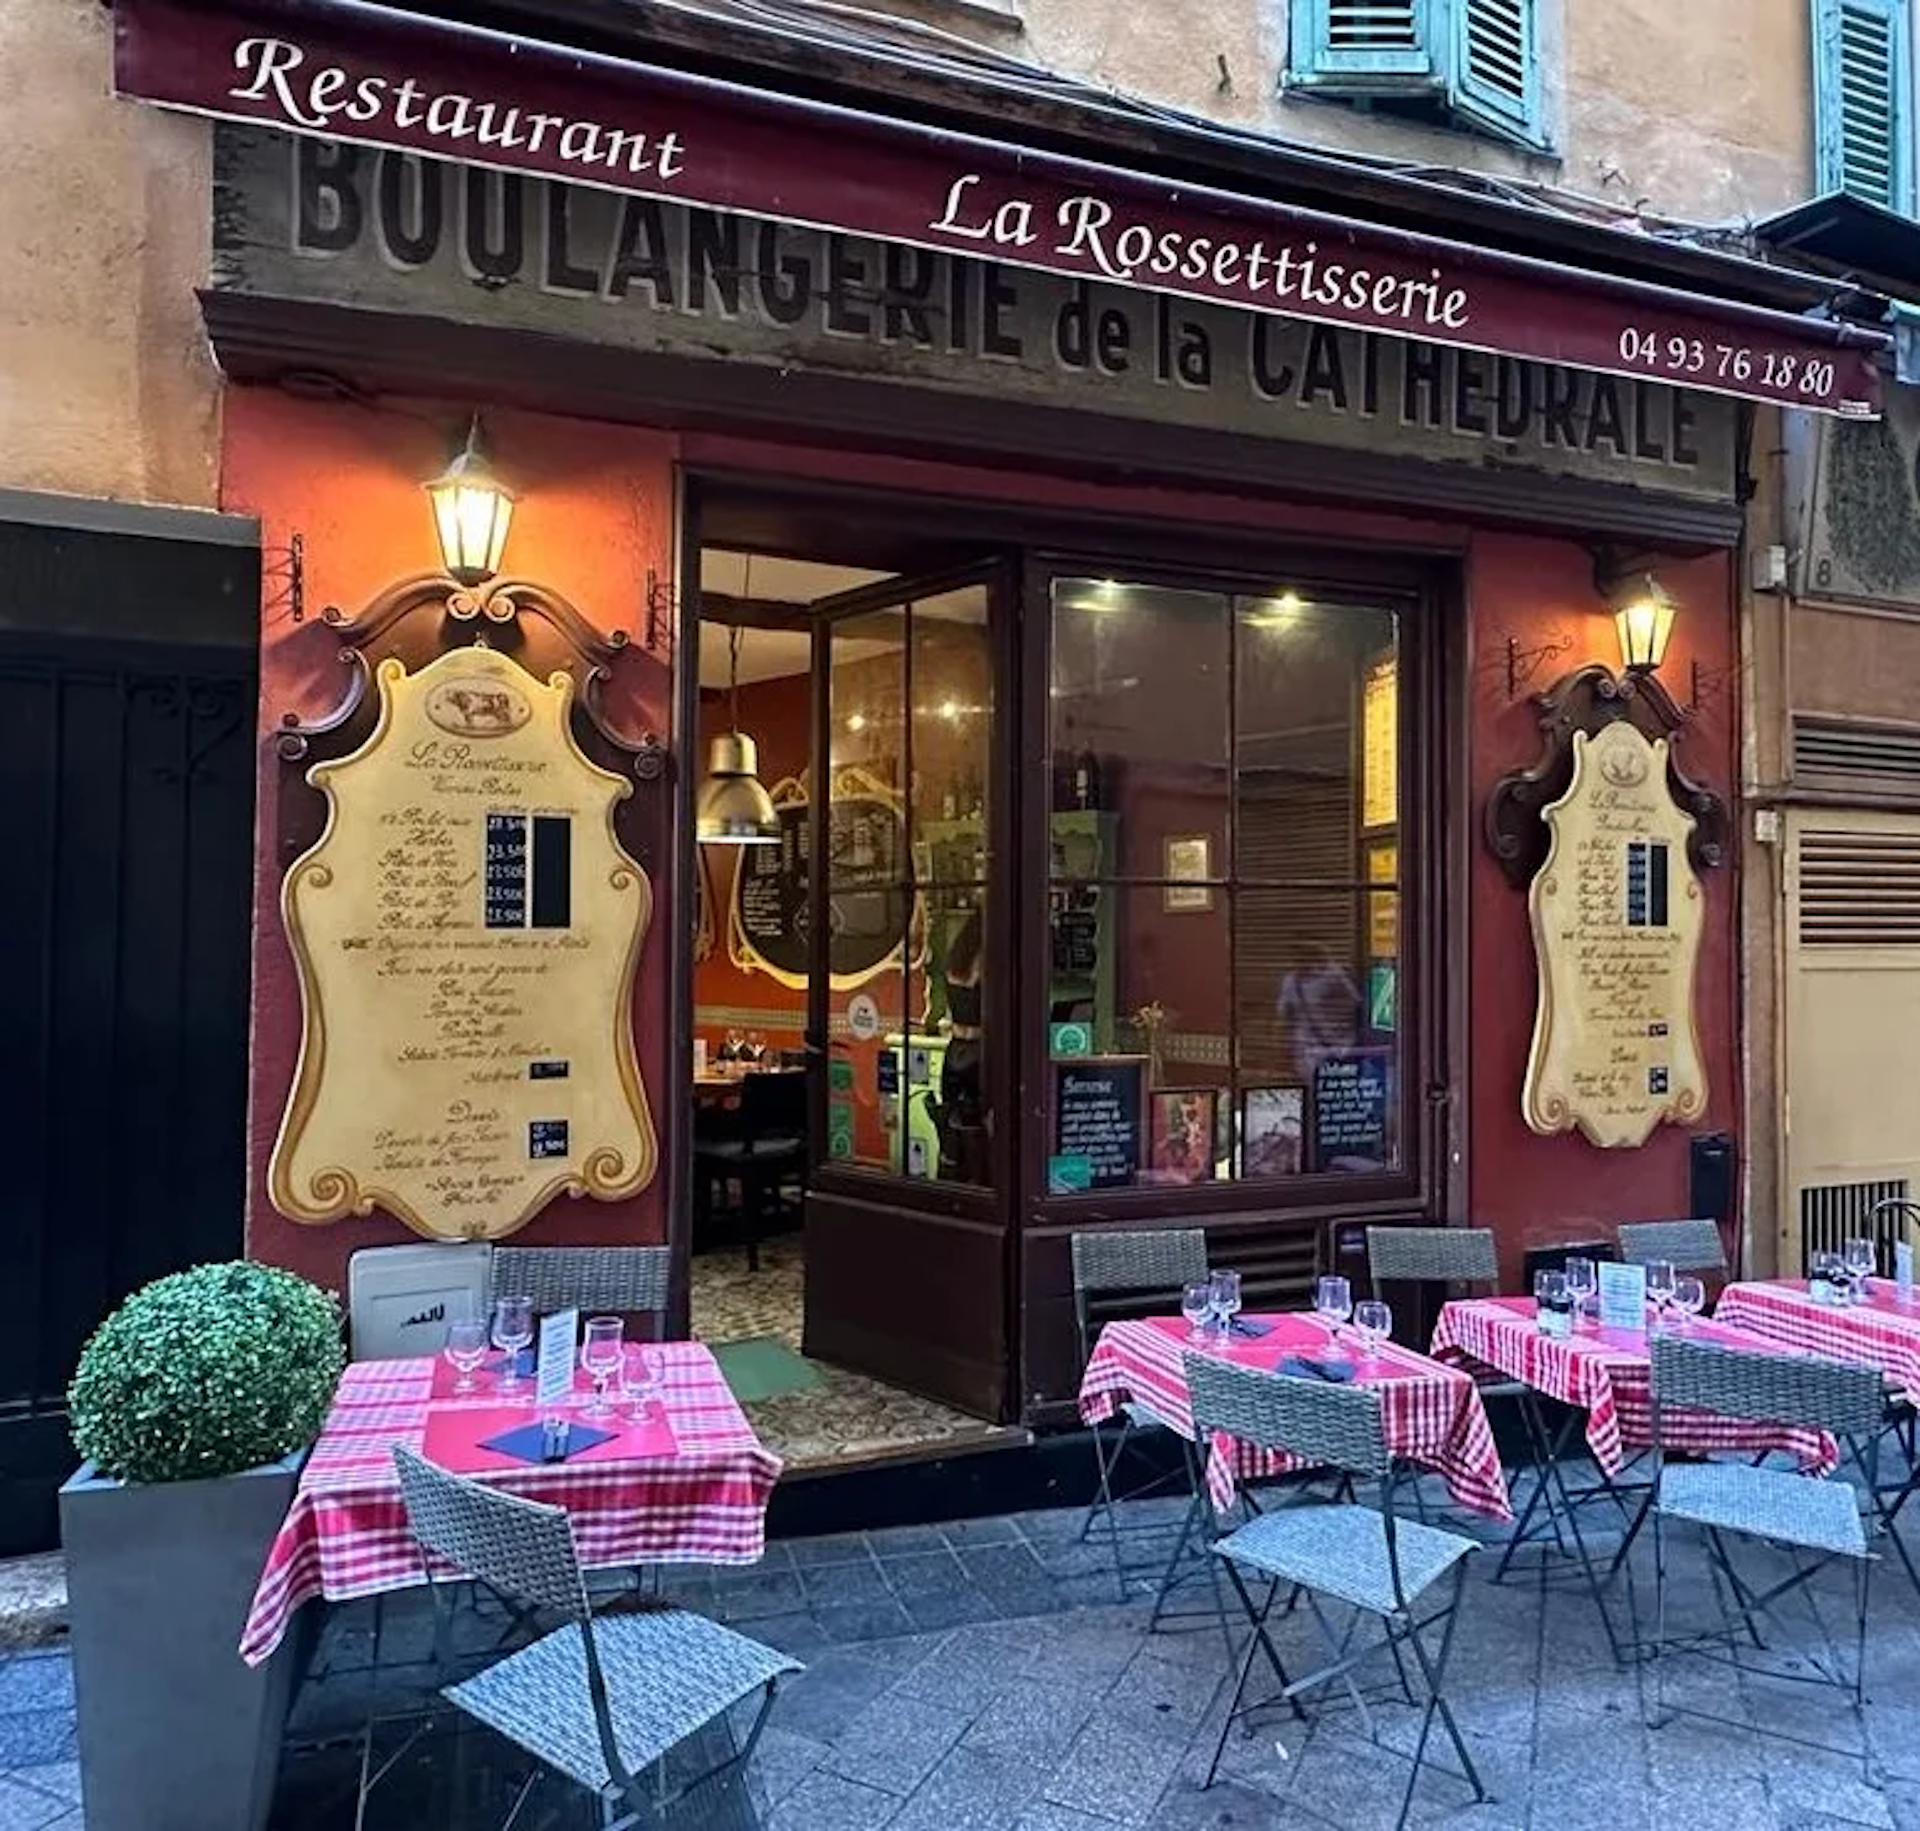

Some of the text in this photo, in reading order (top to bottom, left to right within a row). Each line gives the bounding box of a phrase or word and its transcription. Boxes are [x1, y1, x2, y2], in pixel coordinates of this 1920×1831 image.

[229, 37, 688, 180] Restaurant
[291, 136, 1024, 361] BOULANGERIE
[1054, 276, 1130, 378] de
[1154, 294, 1212, 391] la
[929, 173, 1471, 329] La Rossettisserie
[1619, 327, 1835, 397] 04 93 76 18 80
[1816, 558, 1832, 587] 8
